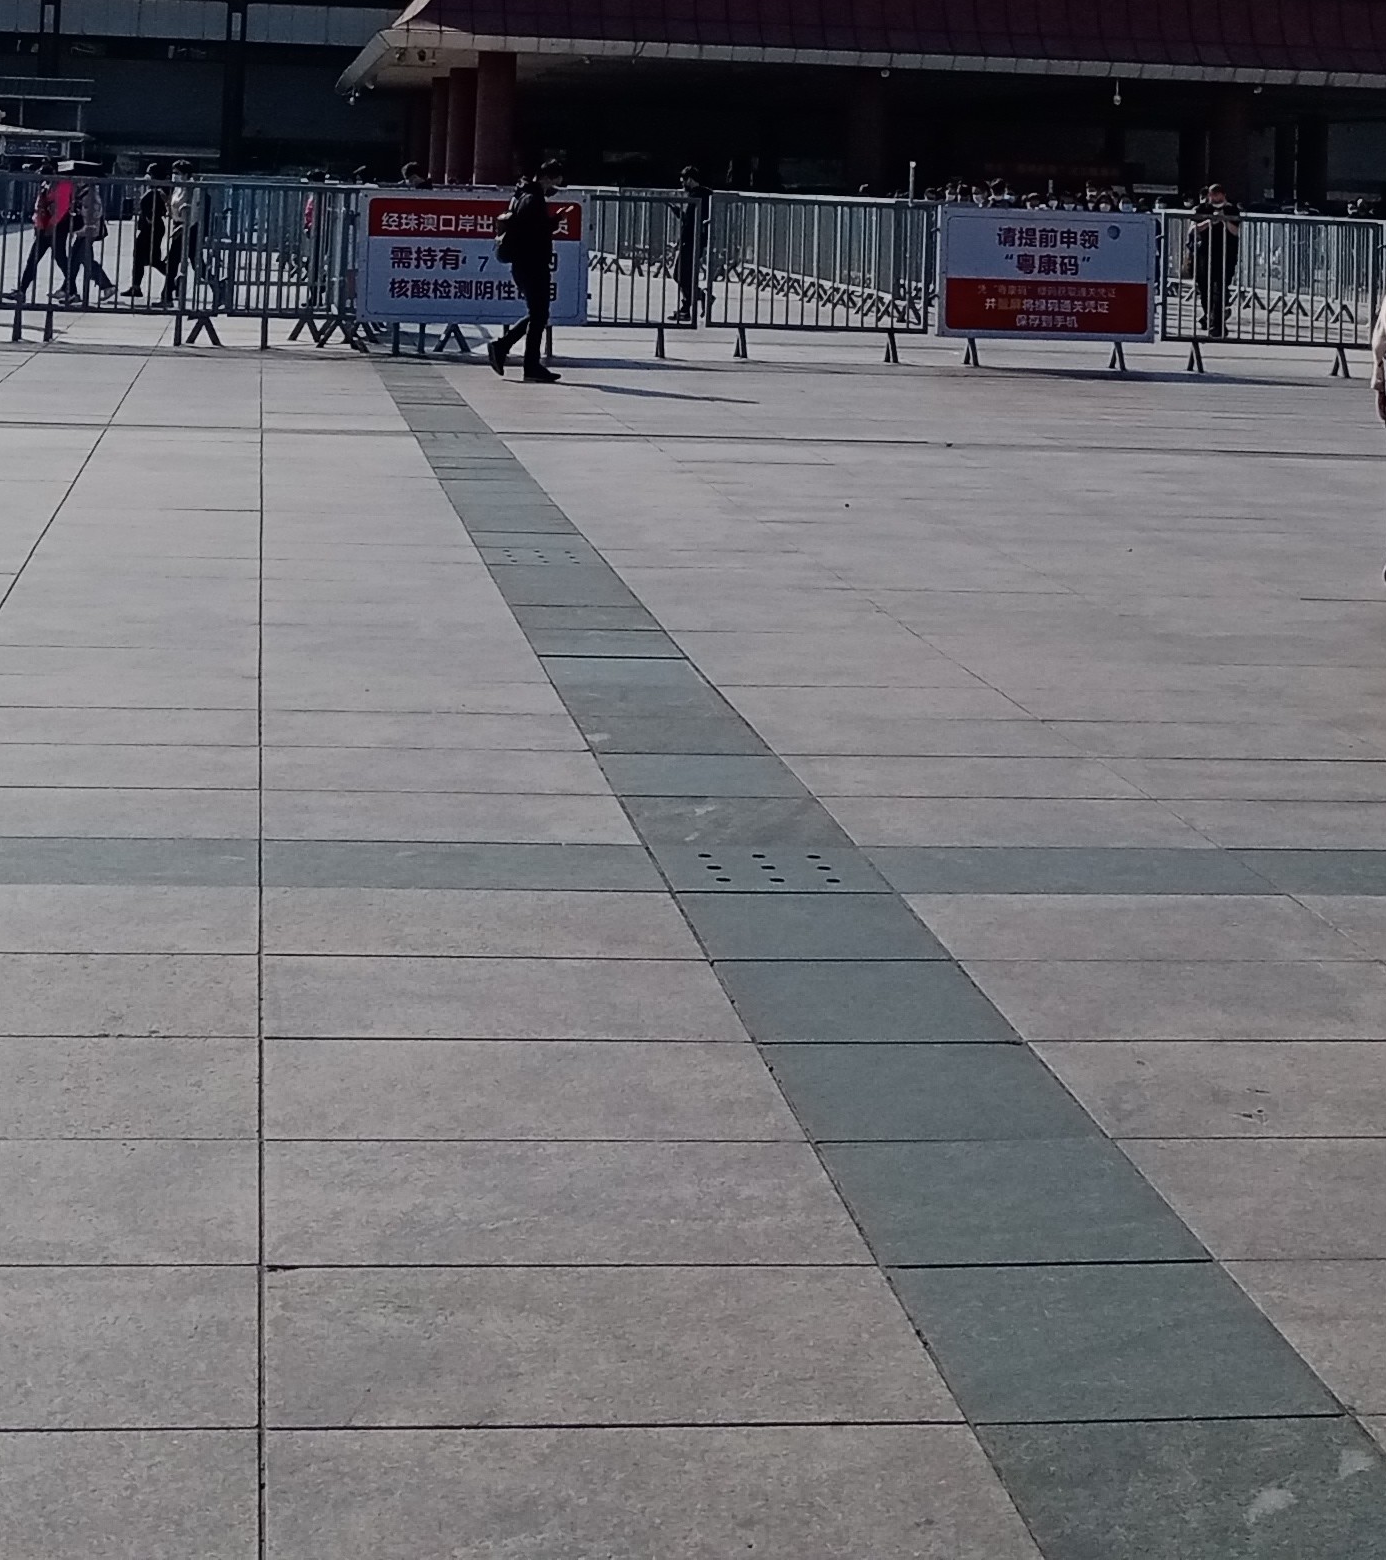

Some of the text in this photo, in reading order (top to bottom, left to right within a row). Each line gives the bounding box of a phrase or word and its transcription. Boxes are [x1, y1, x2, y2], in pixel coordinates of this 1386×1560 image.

[997, 227, 1100, 250] 请提前申领
[389, 278, 557, 301] 核酸检测阴性
